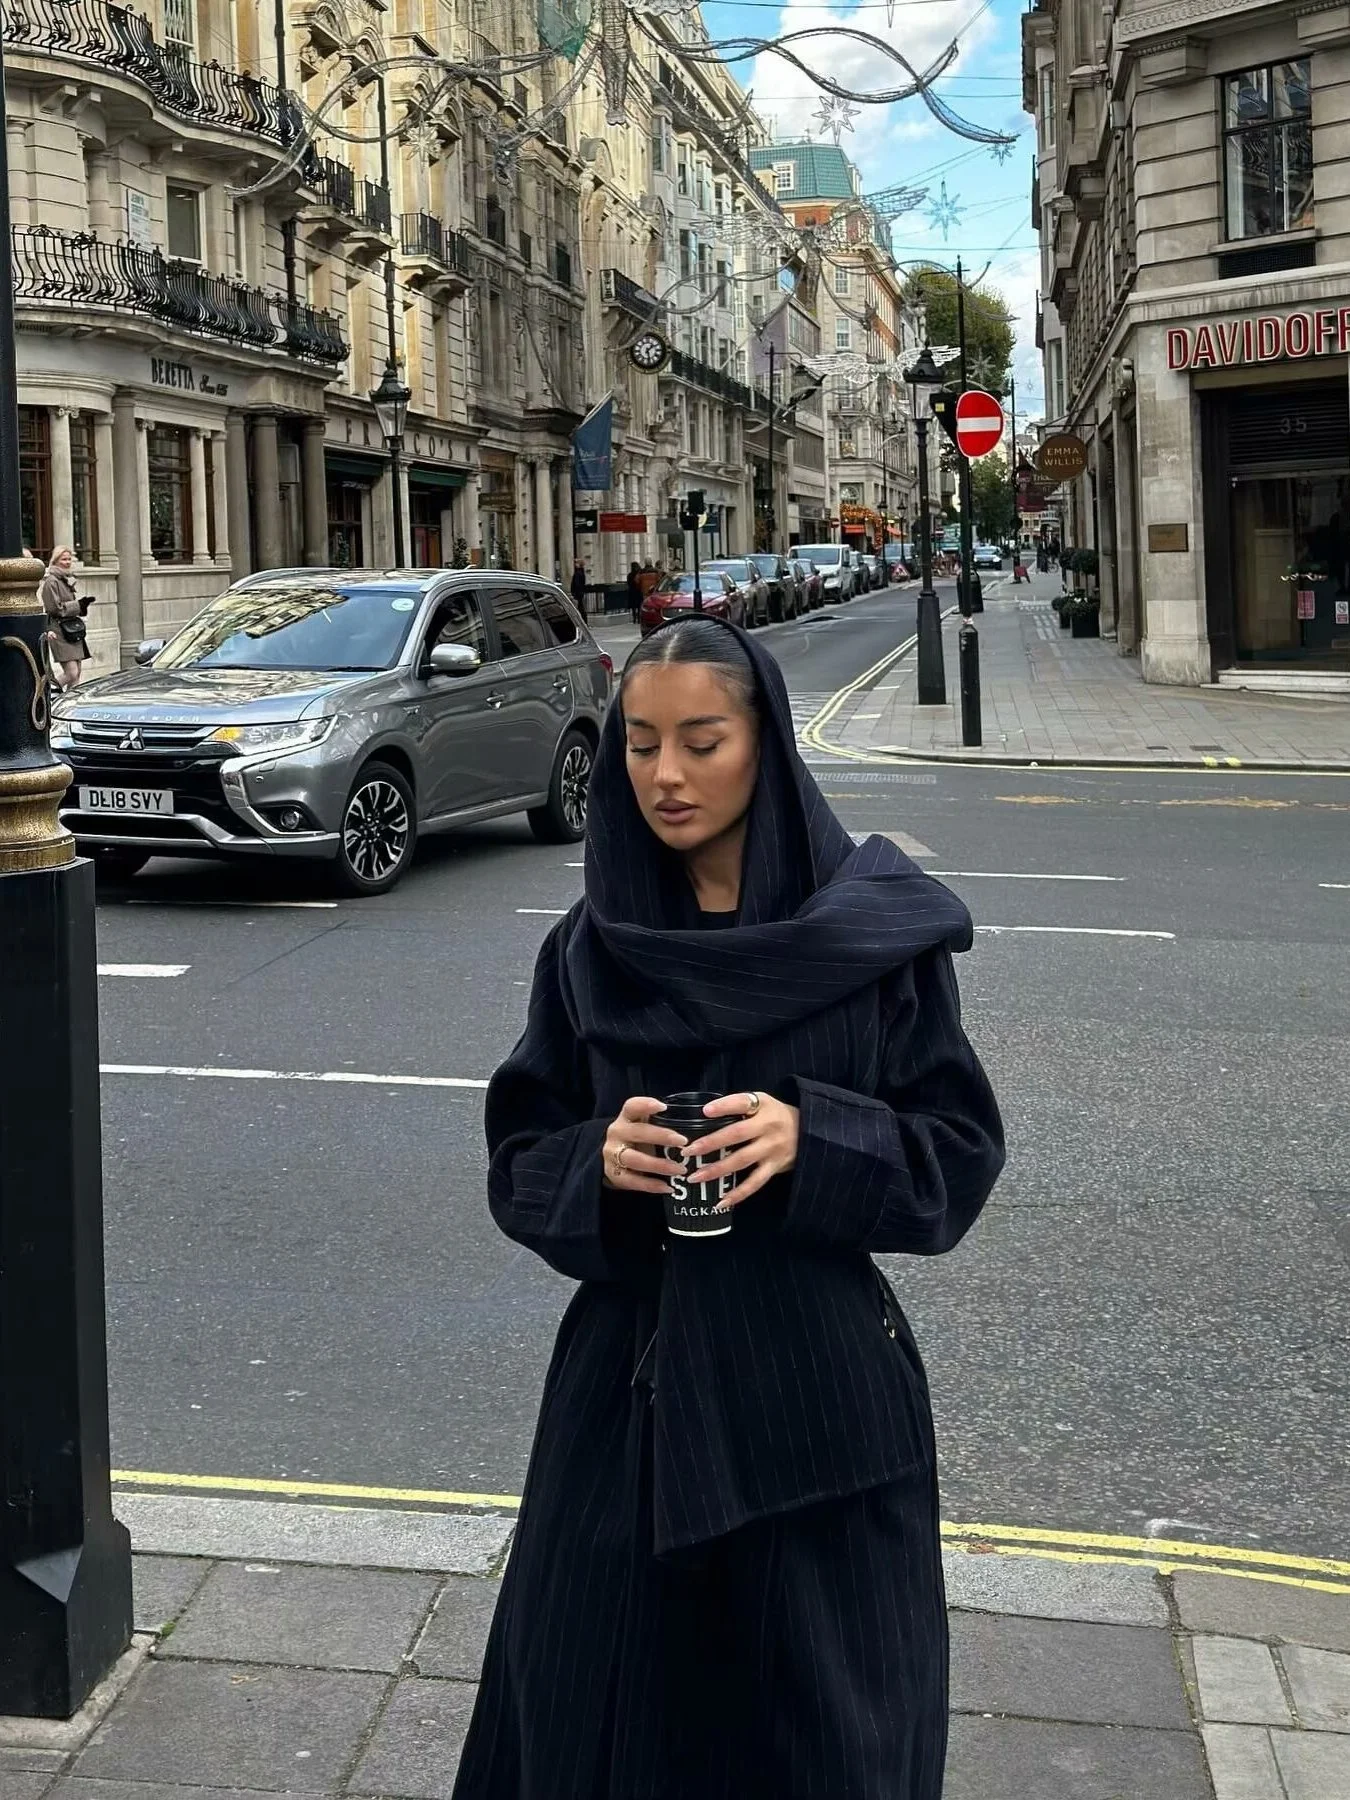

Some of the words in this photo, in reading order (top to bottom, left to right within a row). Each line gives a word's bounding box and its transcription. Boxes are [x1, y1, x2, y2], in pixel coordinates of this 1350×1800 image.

[151, 357, 195, 391] BERETTA
[1280, 416, 1307, 433] 35
[1047, 447, 1080, 456] EMMA
[1044, 457, 1084, 466] WILLIS
[89, 790, 126, 808] DL18
[130, 792, 163, 810] SVY
